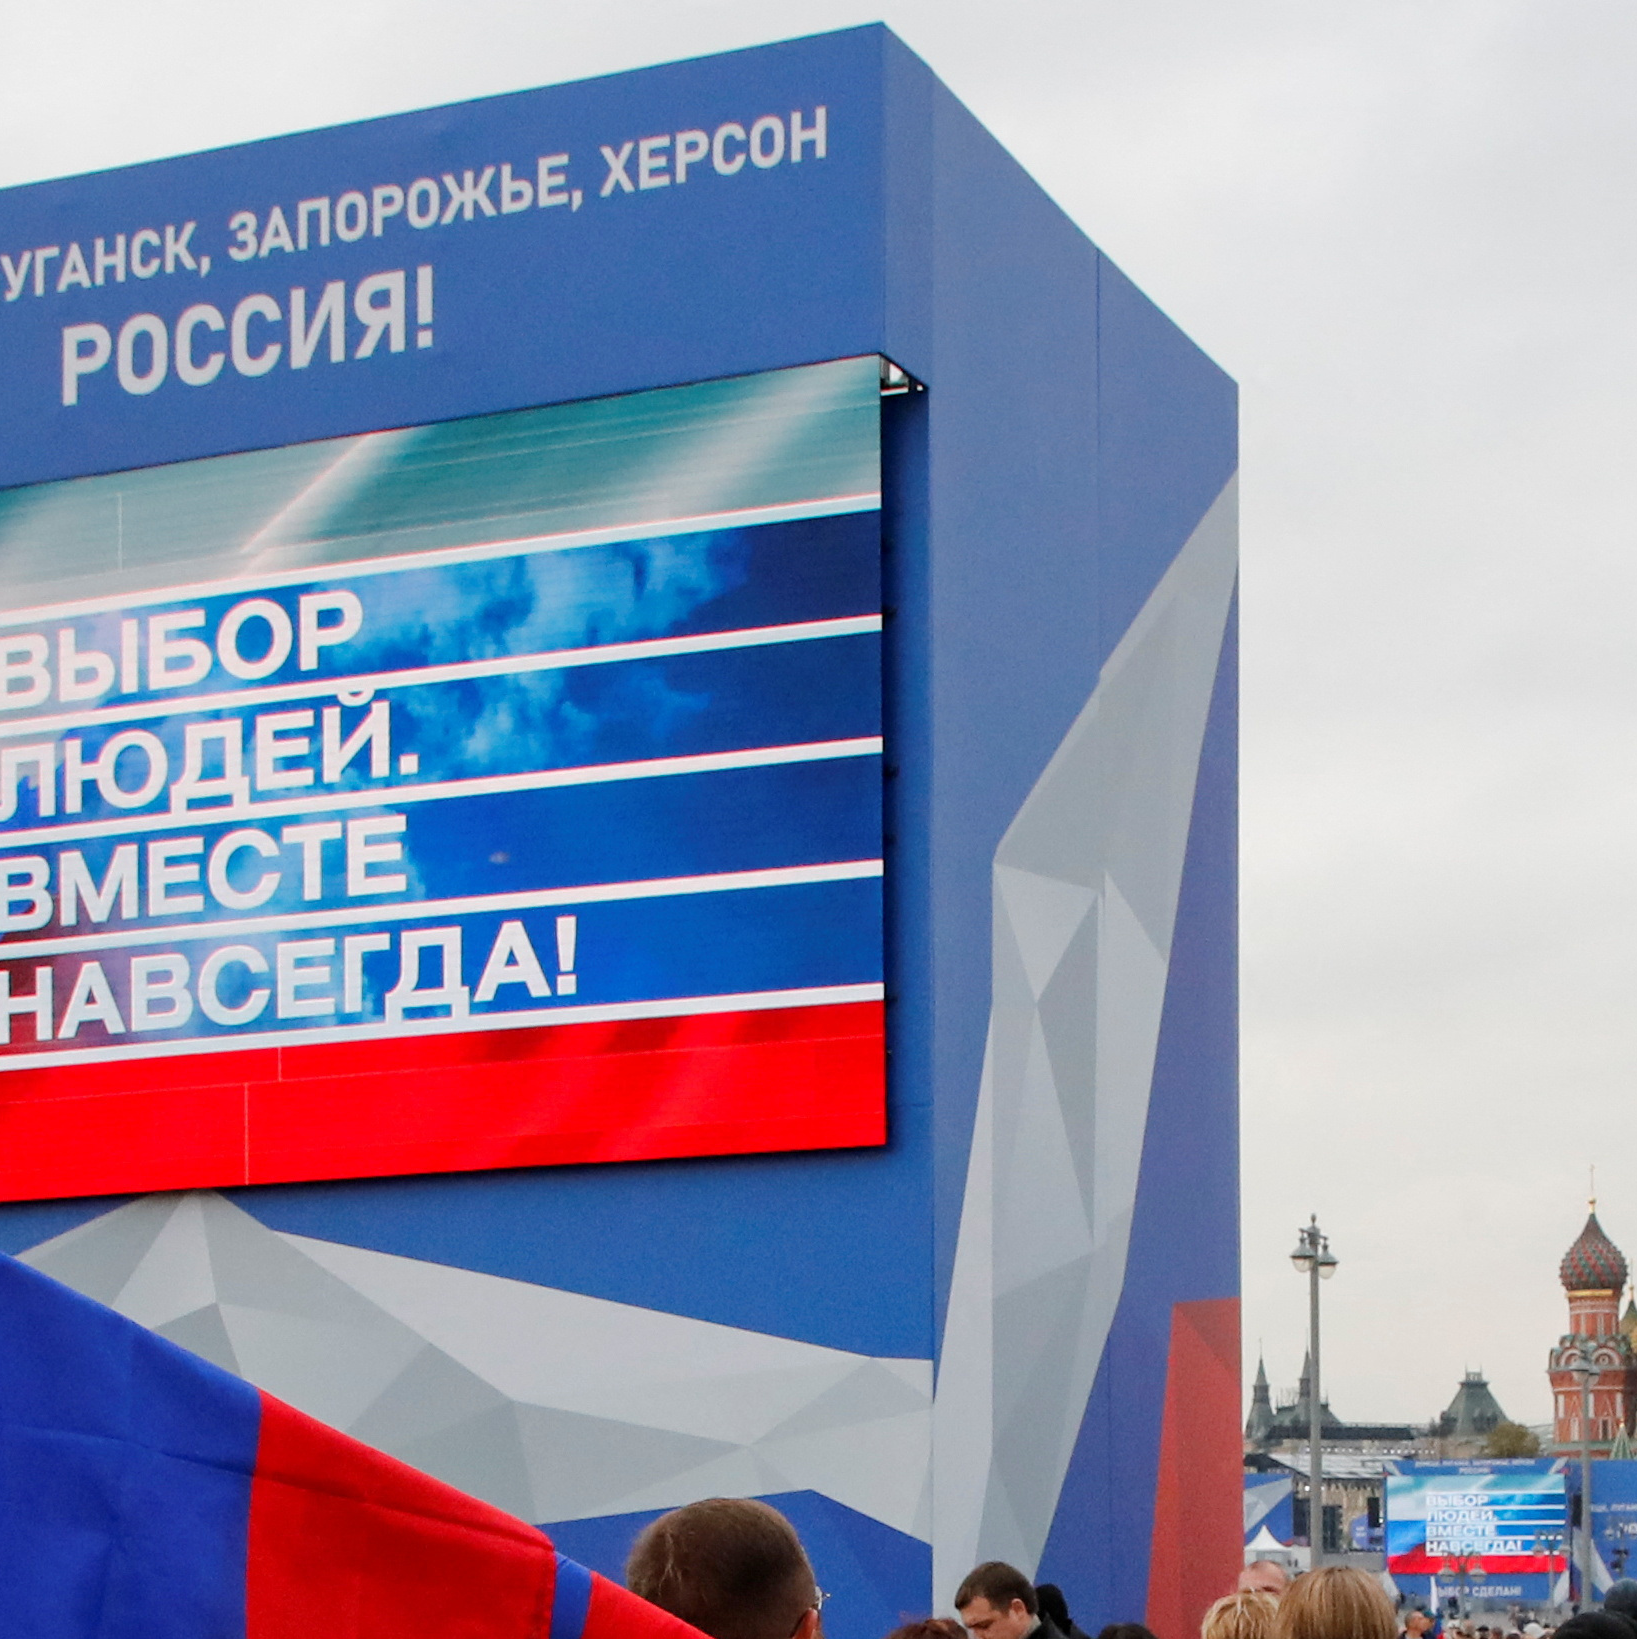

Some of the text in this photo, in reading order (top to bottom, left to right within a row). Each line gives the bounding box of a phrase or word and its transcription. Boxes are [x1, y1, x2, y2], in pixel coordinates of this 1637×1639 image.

[227, 151, 582, 265] ЗАПОРОЖЬЕ,
[599, 105, 828, 196] ХЕРСОН
[61, 263, 436, 407] РОССИЯ!
[1426, 1494, 1489, 1507] ВЫБОР
[1427, 1508, 1497, 1522] ЛЮДЕЙ.
[1426, 1524, 1497, 1537] ВМЕСТЕ
[1426, 1540, 1522, 1554] НАВСЕГДА!
